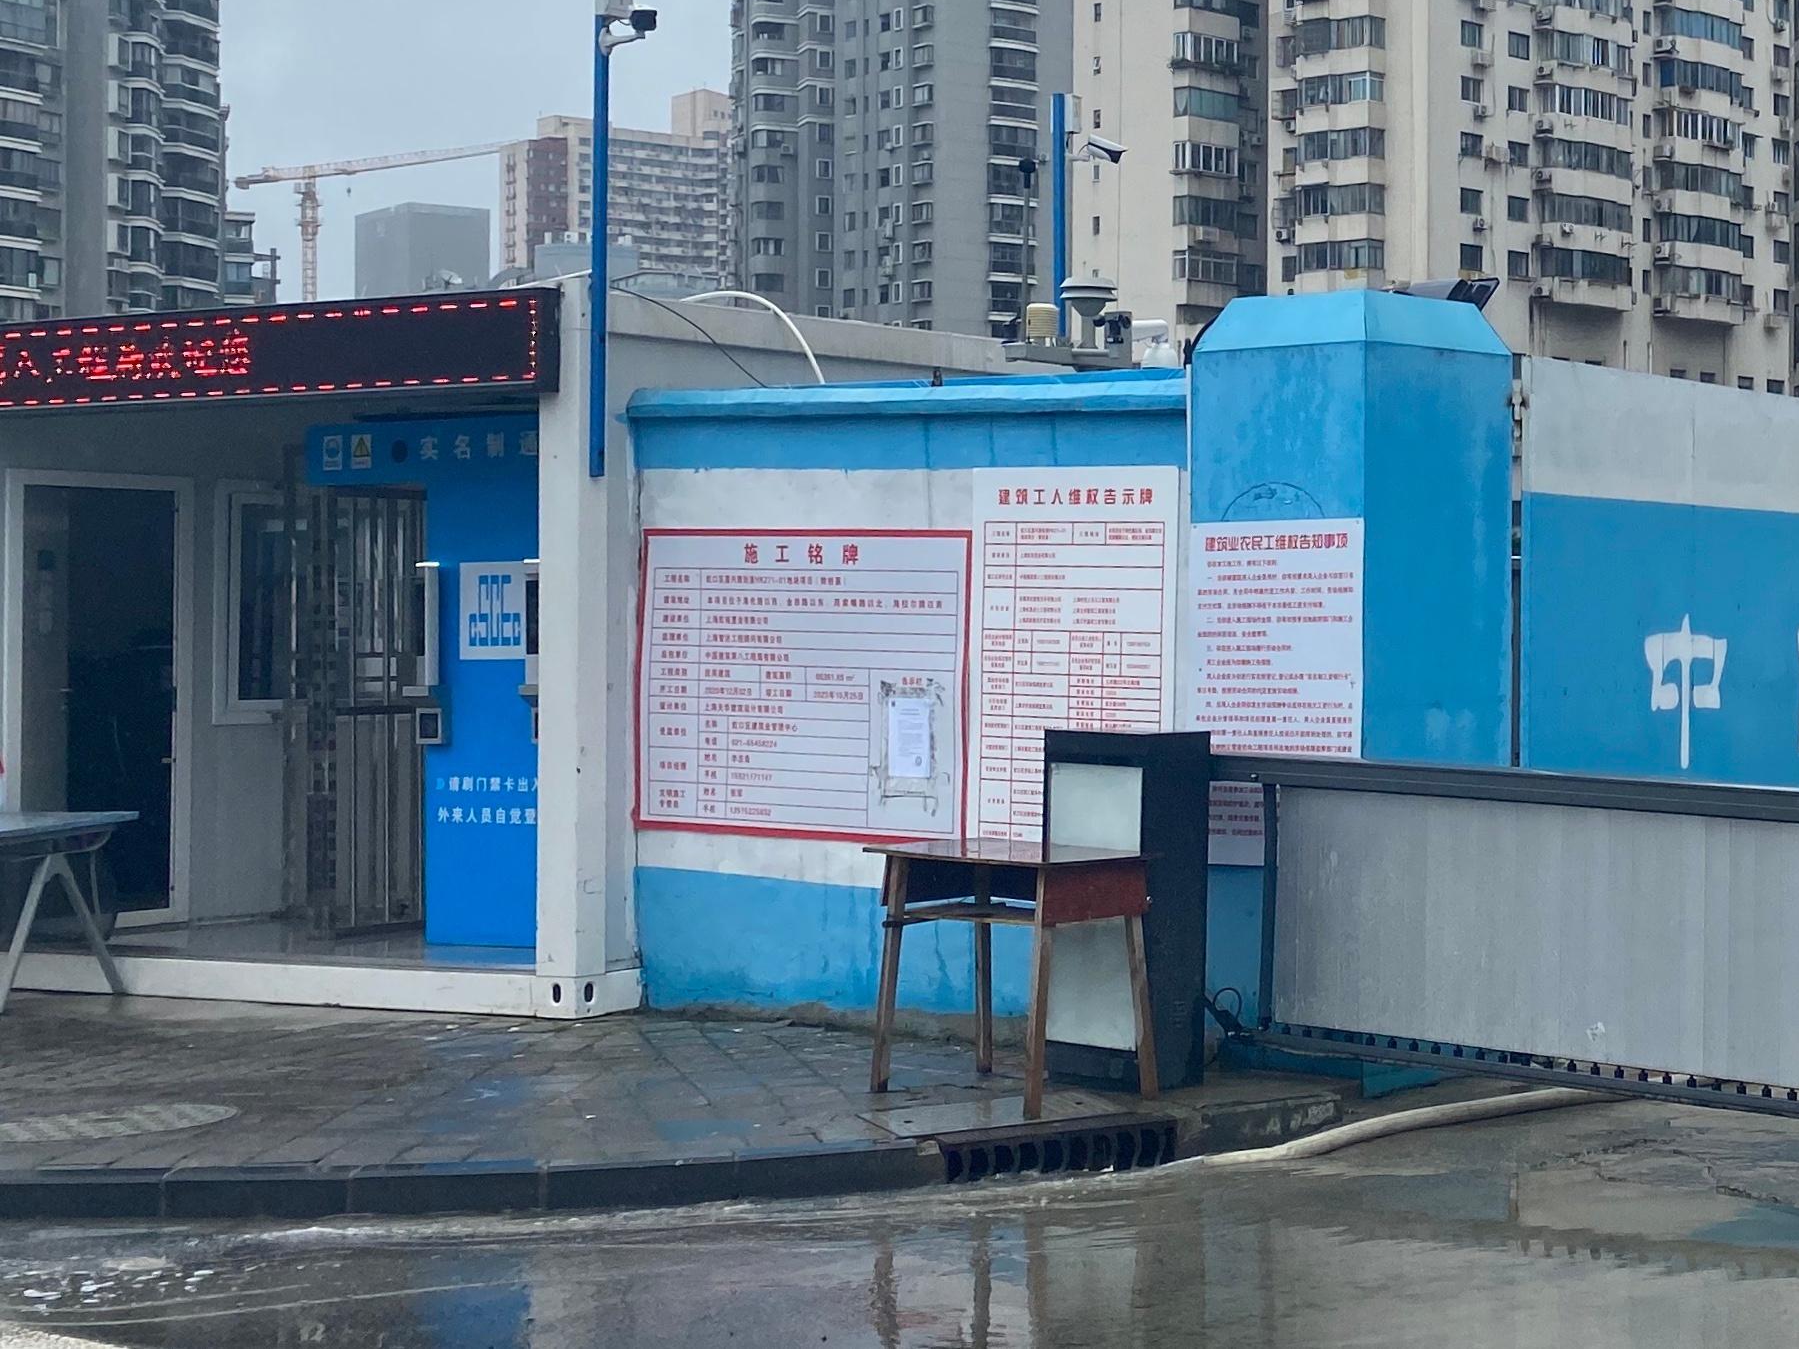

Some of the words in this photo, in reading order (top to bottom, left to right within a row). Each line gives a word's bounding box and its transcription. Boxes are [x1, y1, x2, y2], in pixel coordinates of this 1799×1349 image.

[998, 488, 1153, 505] 建筑工人维权告示牌
[1205, 532, 1348, 551] 建筑业农民工维权告知事项
[744, 543, 859, 565] 施工铭牌
